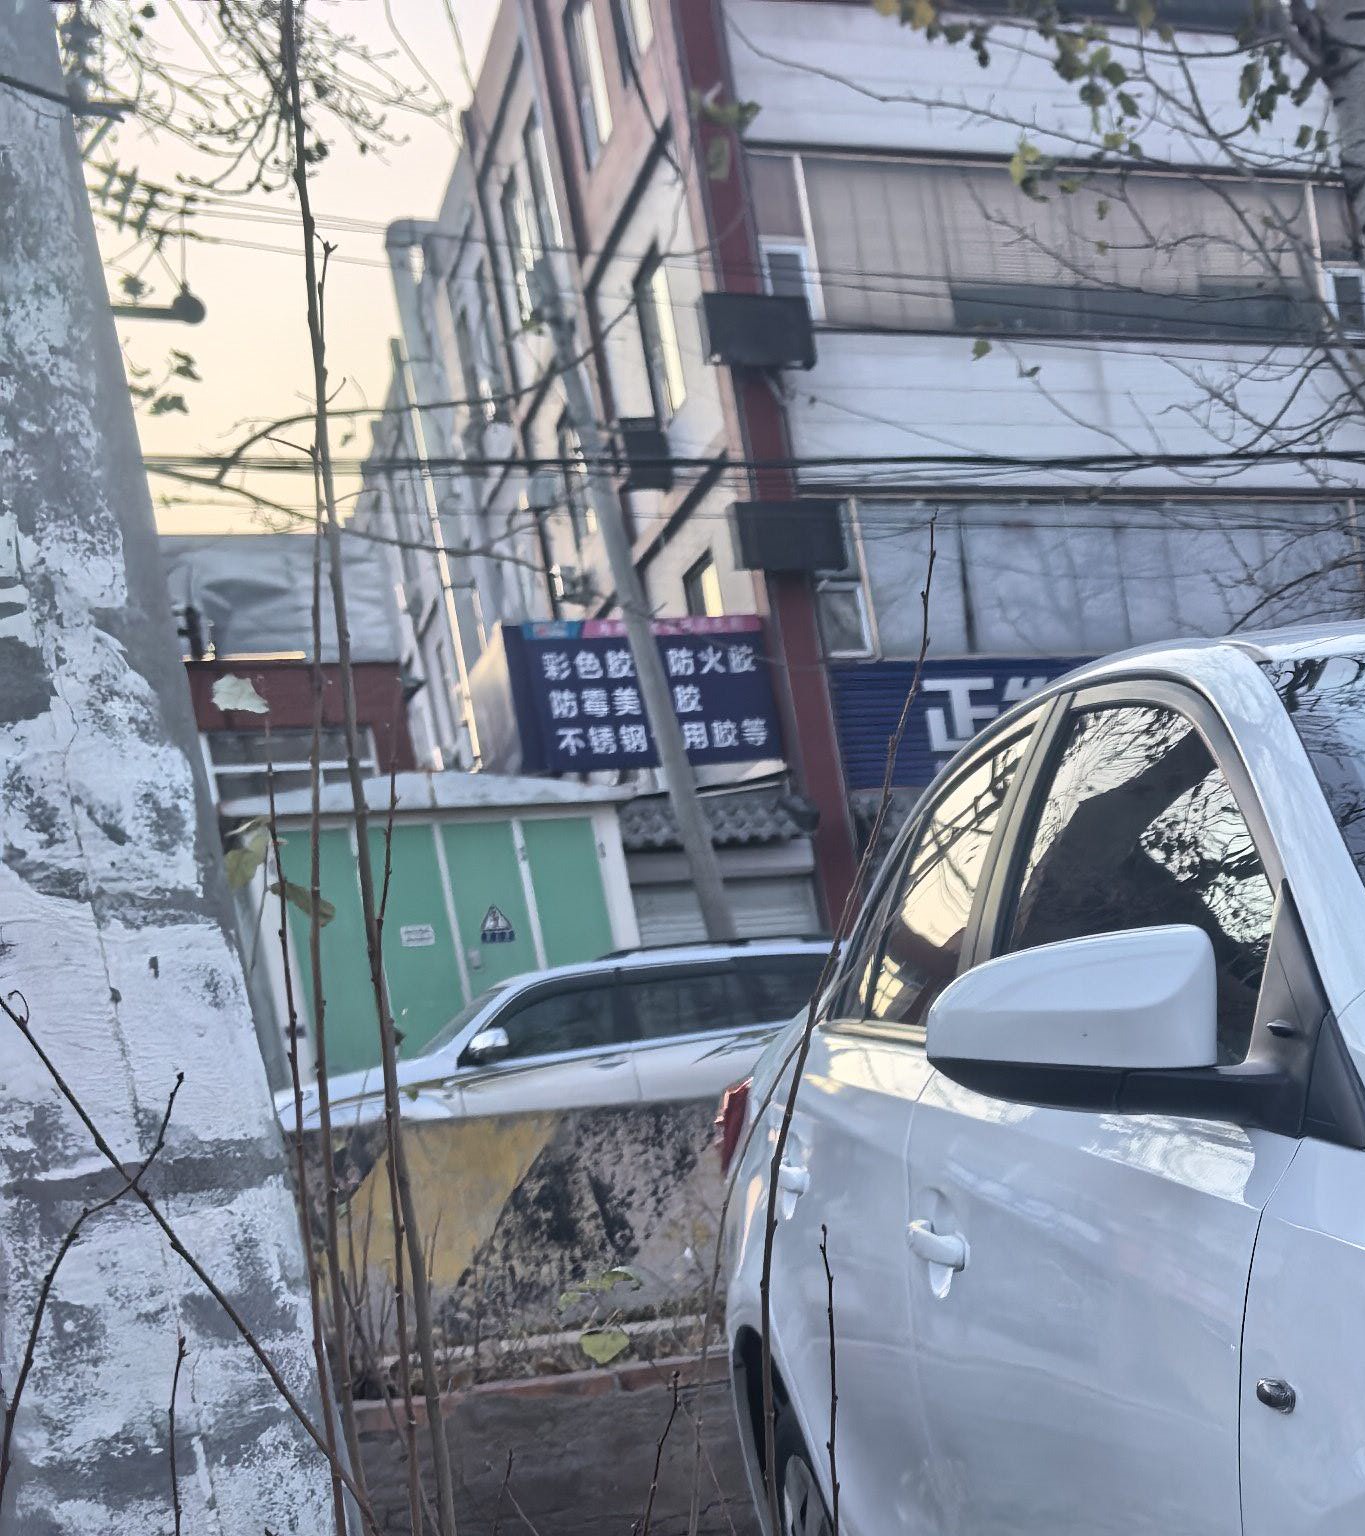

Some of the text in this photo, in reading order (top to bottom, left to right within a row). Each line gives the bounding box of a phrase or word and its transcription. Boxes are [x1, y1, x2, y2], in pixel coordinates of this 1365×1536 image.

[548, 684, 703, 719] 防霉美胶
[556, 717, 768, 756] 不锈钢用胶等
